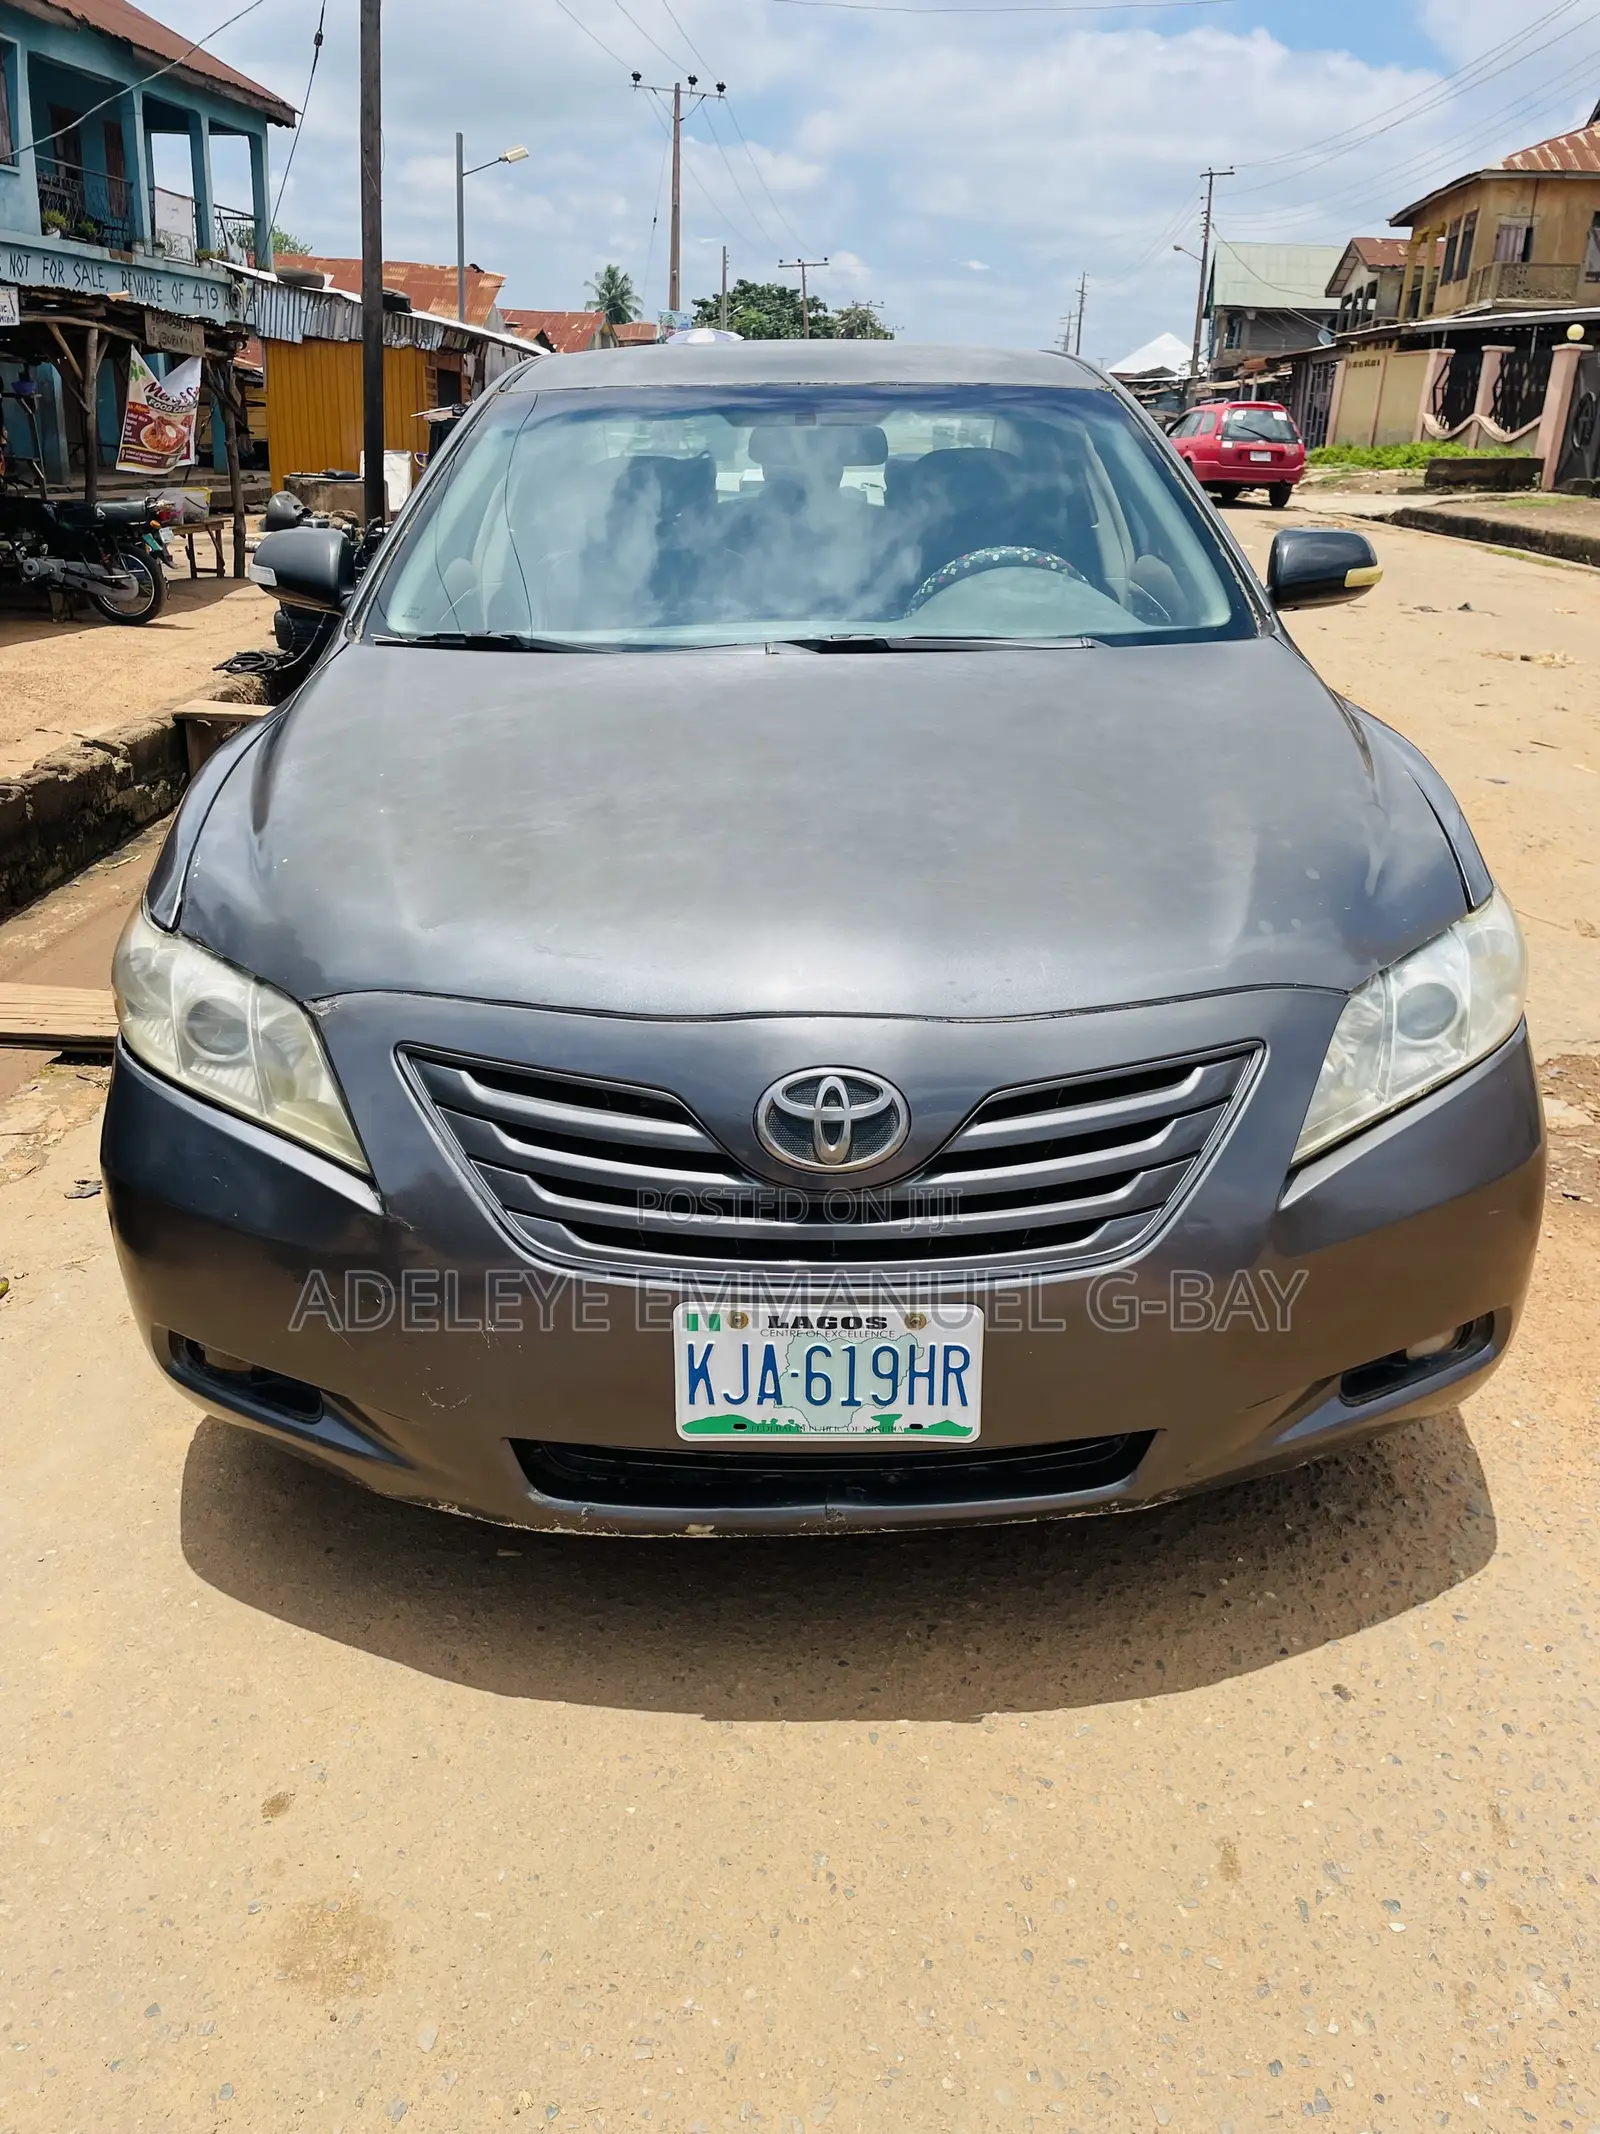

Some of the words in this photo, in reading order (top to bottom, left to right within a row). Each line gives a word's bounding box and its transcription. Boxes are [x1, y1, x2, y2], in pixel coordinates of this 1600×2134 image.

[9, 252, 31, 278] NOT
[42, 256, 65, 284] FOR
[73, 261, 108, 292] SALE,
[121, 270, 163, 303] BEWARE
[171, 281, 184, 305] OF
[149, 398, 173, 412] FOOD
[767, 1315, 888, 1330] LAGOS
[760, 1329, 800, 1338] CENTRE
[805, 1330, 821, 1338] OF
[825, 1330, 896, 1338] EXCELLENCE
[686, 1343, 971, 1407] KJA-619HR
